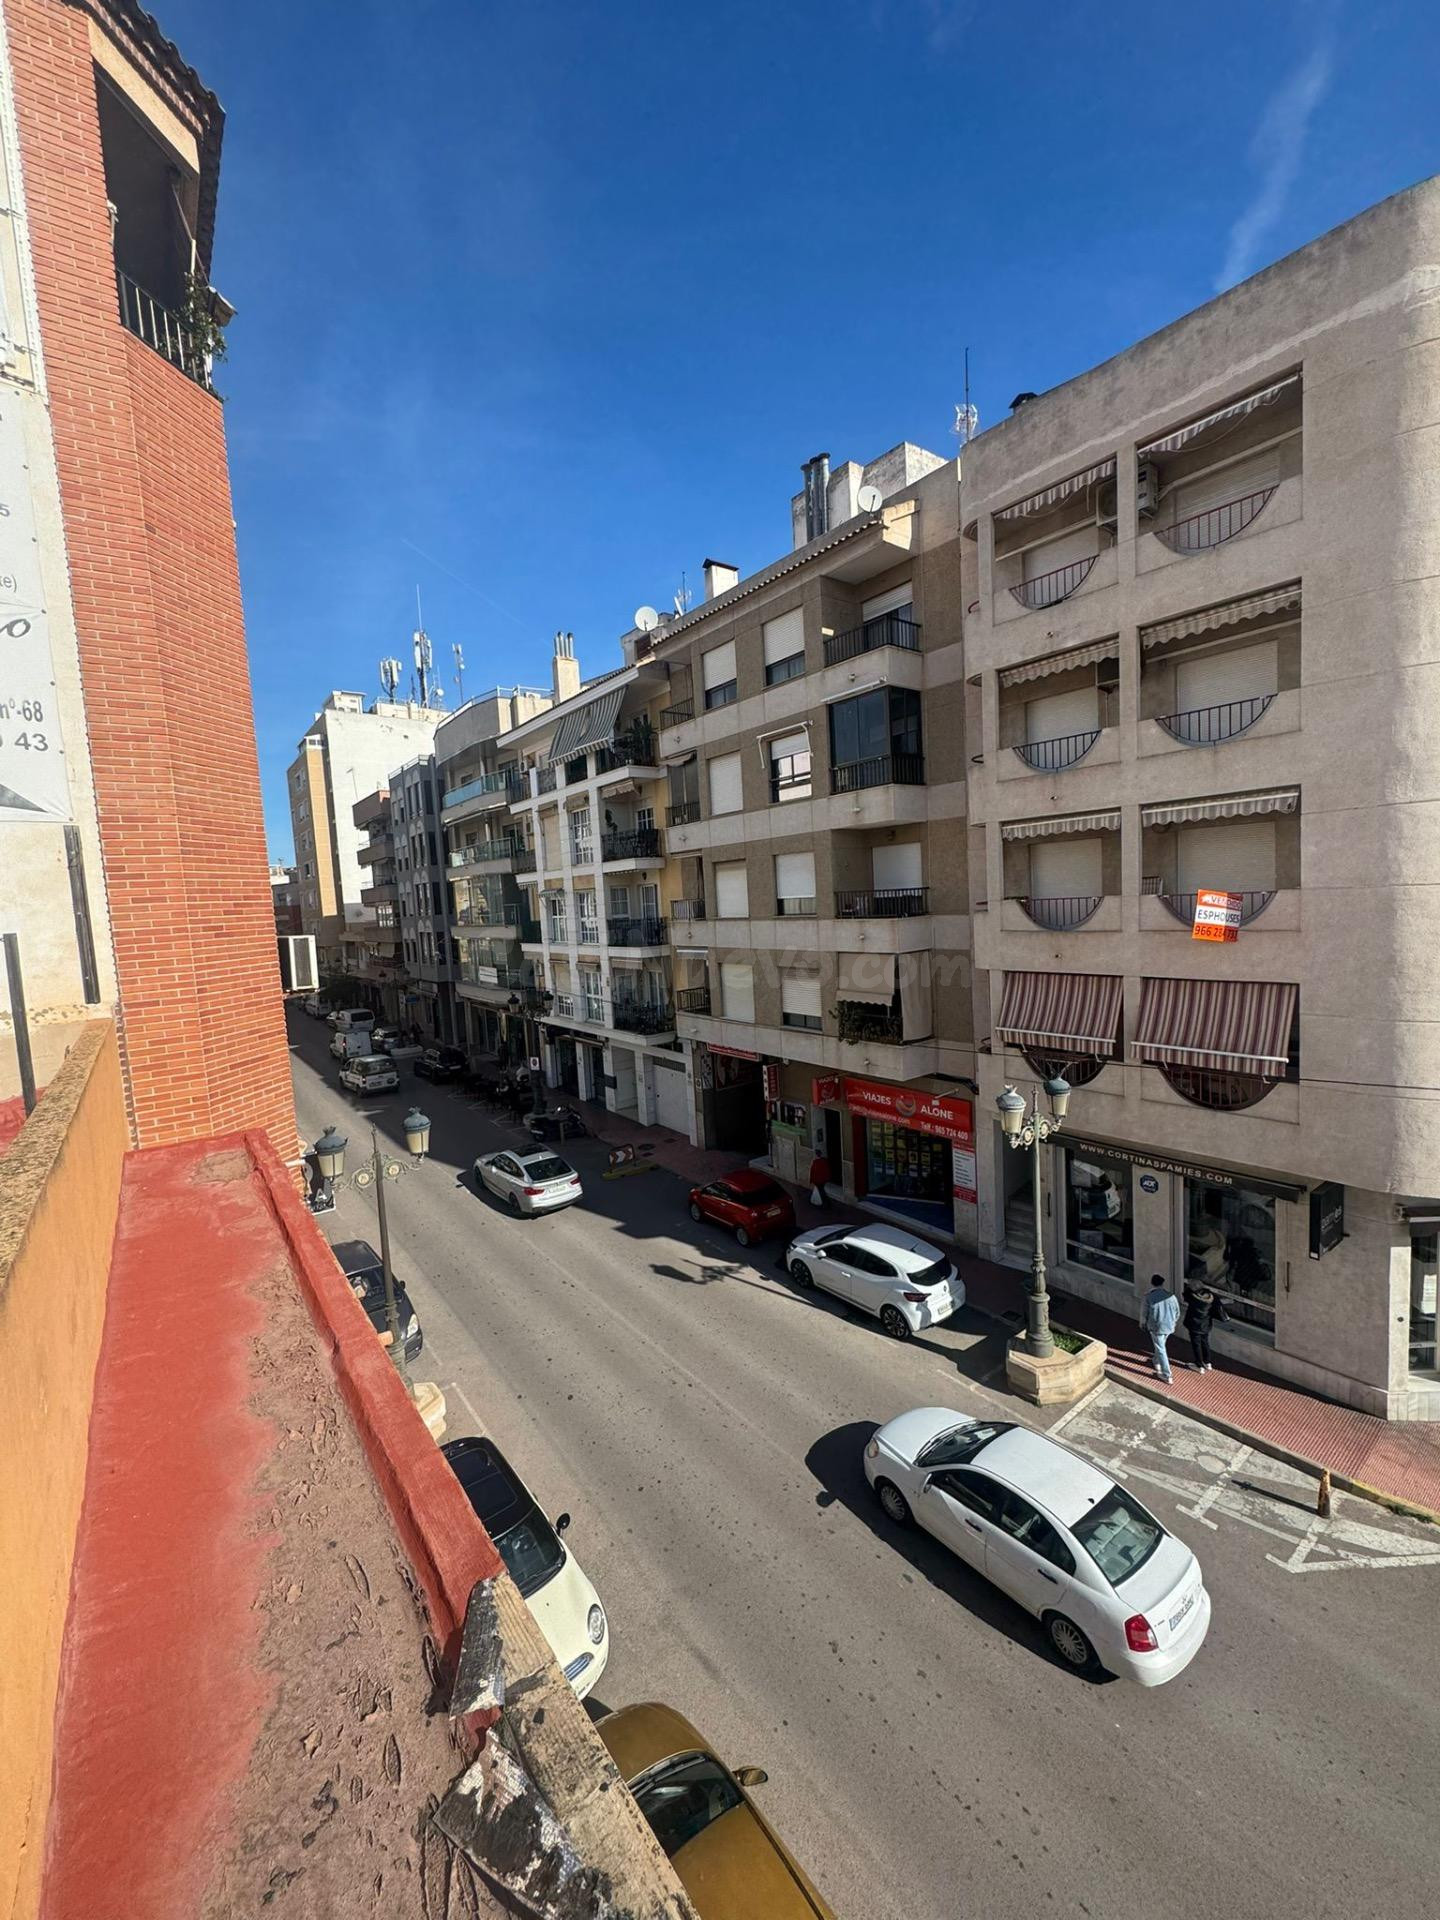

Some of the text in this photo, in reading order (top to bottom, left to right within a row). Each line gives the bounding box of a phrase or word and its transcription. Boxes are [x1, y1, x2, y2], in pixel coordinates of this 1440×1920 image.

[14, 732, 49, 751] 43
[1194, 925, 1212, 936] 966
[862, 1091, 892, 1106] VIAJES
[920, 1104, 955, 1121] ALONE
[1079, 1143, 1233, 1185] WWW.CORTINASPAMIES.COM
